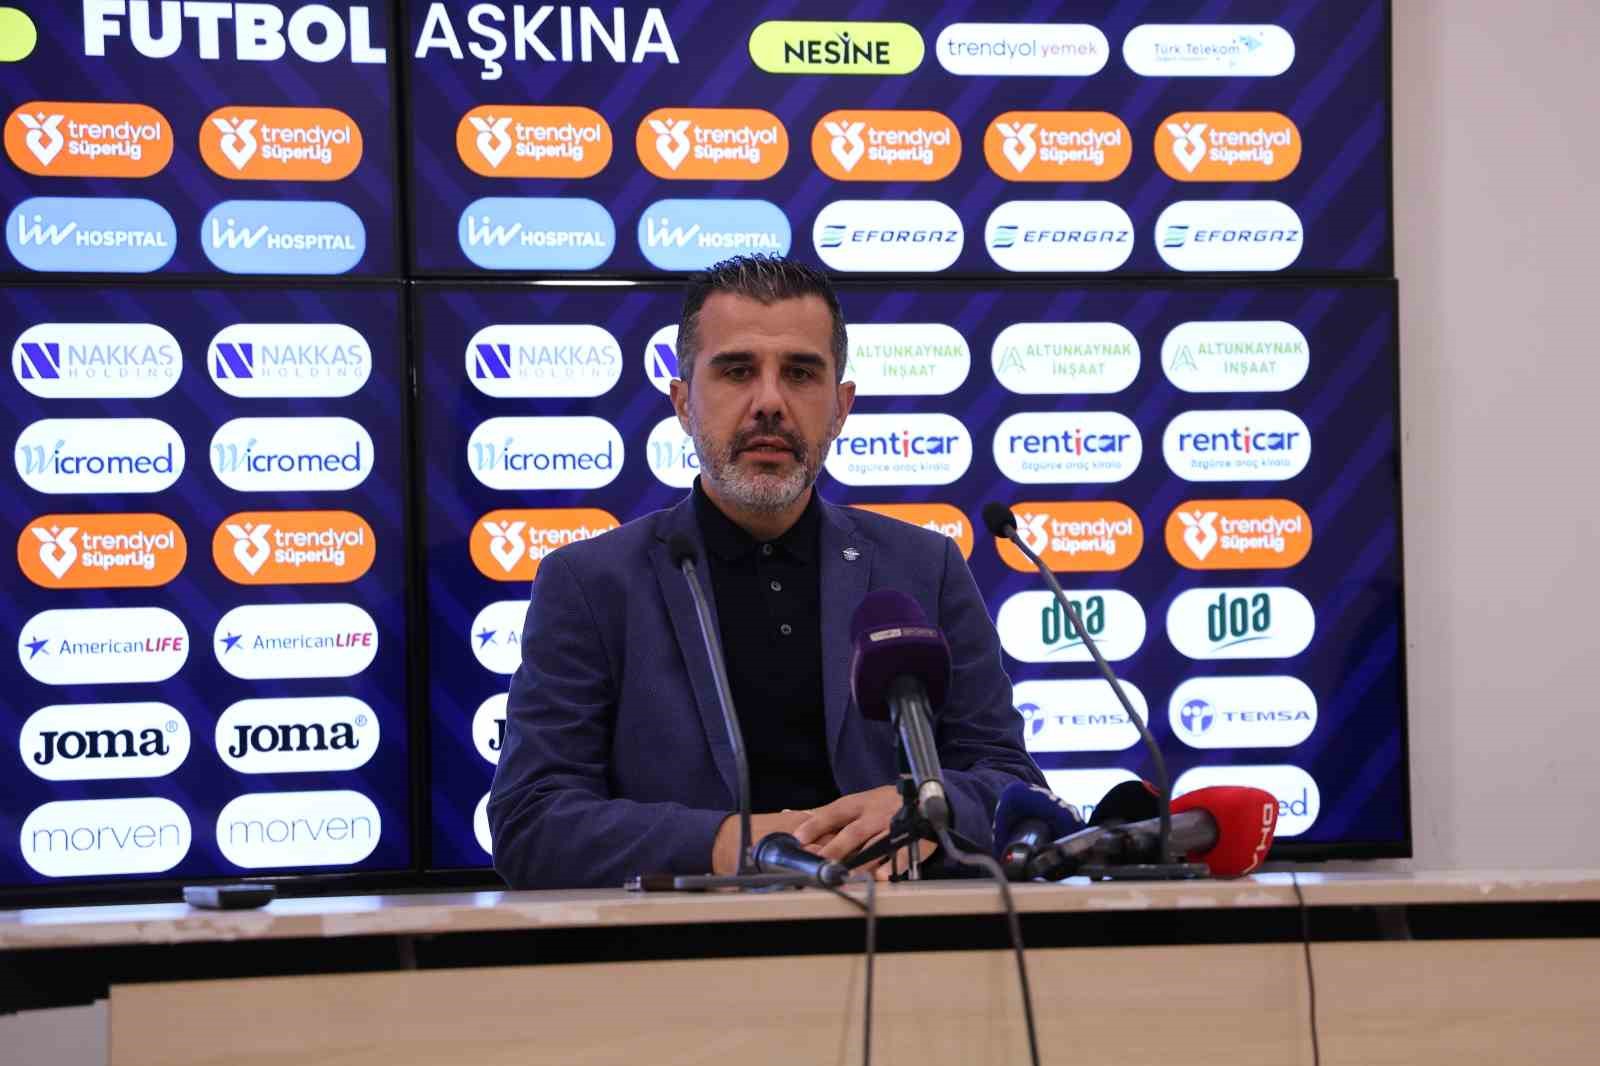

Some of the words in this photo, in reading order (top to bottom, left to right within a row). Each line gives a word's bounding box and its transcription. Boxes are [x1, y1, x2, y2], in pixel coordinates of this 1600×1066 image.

[82, 0, 387, 64] FUTBOL
[414, 2, 680, 80] AŞKINA
[948, 39, 1036, 58] trendyol
[1041, 43, 1097, 57] yemek
[68, 120, 161, 143] trendyol
[261, 124, 351, 147] trendyol
[516, 122, 601, 144] trendyol
[694, 126, 778, 147] trendyol
[868, 127, 950, 147] trendyol
[1040, 128, 1122, 148] trendyol
[1209, 128, 1292, 148] trendyol
[75, 231, 168, 247] HOSPITAL
[267, 233, 356, 250] HOSPITAL
[521, 231, 606, 248] HOSPITAL
[699, 232, 781, 249] HOSPITAL
[851, 231, 958, 243] EFORGAZ
[1023, 230, 1129, 243] EFORGAZ
[1194, 230, 1300, 243] EFORGAZ
[856, 344, 963, 358] ALTUNKAYNAK
[1026, 343, 1132, 357] ALTUNKAYNAK
[1198, 341, 1303, 355] ALTUNKAYNAK
[68, 367, 174, 379] HOLDING
[261, 366, 363, 378] HOLDING
[519, 367, 615, 377] HOLDING
[836, 430, 959, 458] renticar
[1009, 428, 1131, 456] renticar
[1178, 426, 1300, 453] renticar
[1051, 519, 1132, 540] trendyol
[1221, 516, 1302, 537] trendyol
[81, 531, 174, 554] trendyol
[274, 528, 364, 551] trendyol
[1042, 595, 1105, 646] doa
[1208, 592, 1271, 642] doa
[59, 637, 183, 656] AmericanLIFE
[253, 632, 373, 650] AmericanLIFE
[1223, 710, 1311, 722] TEMSA
[32, 824, 181, 852] morven
[229, 816, 372, 843] morven
